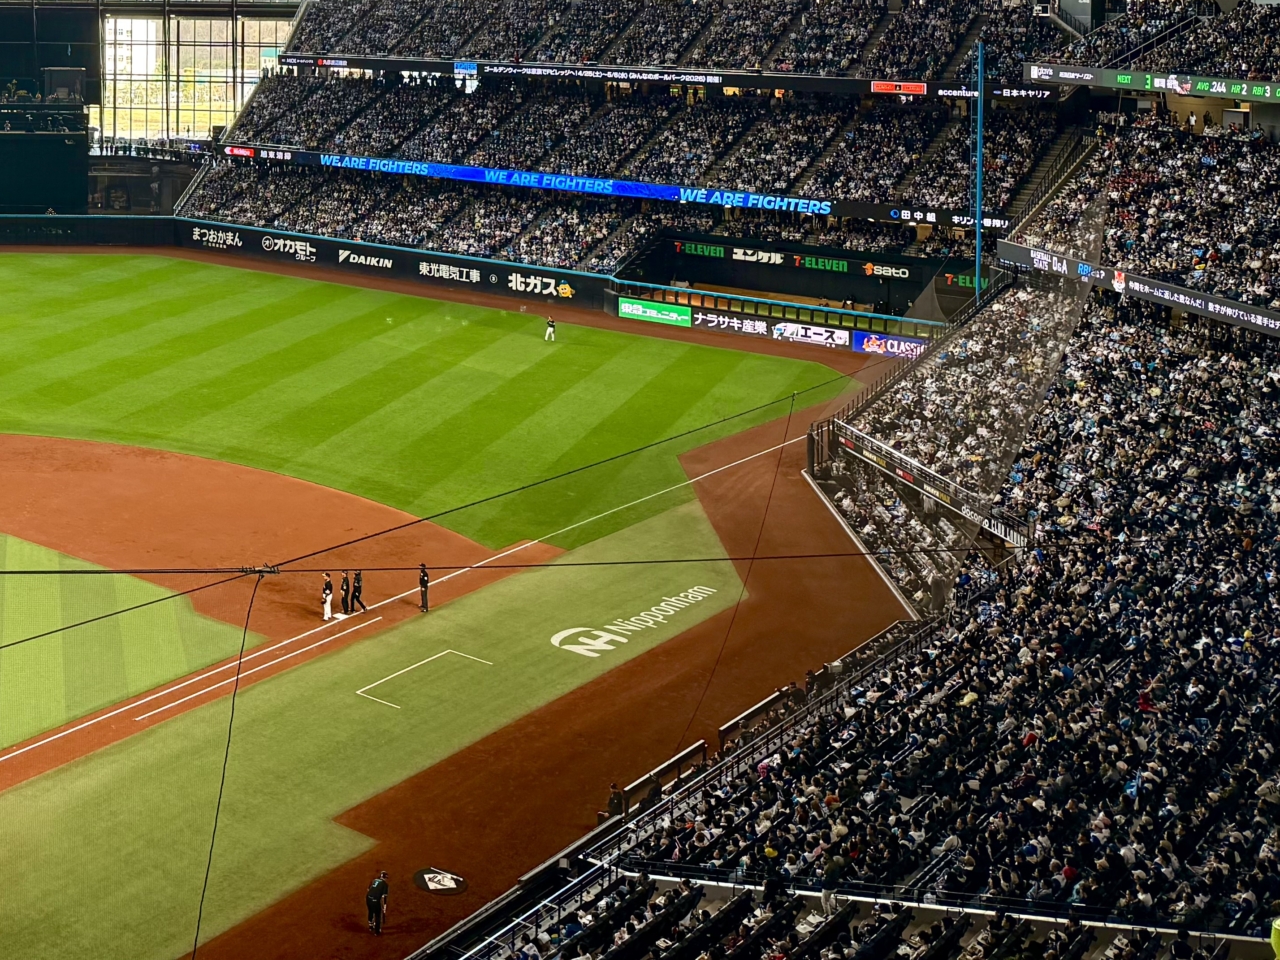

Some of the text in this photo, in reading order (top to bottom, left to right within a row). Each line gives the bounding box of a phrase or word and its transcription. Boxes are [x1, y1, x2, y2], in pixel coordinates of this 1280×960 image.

[1117, 74, 1132, 84] NEXT
[938, 89, 979, 97] accenture
[1002, 89, 1050, 98] 日本キャリア
[1196, 81, 1271, 97] AVG .244 HR 2 RBI 3
[320, 154, 428, 175] WE ARE FIGHTERS
[484, 170, 613, 193] WE ARE FIGHTERS
[680, 188, 832, 215] WE ARE FIGHTERS
[901, 209, 936, 222] 田中組
[951, 215, 1009, 228] キリン番搾り
[192, 226, 242, 247] まつおかまん
[274, 238, 316, 256] オカモト
[295, 253, 316, 262] グループ
[349, 253, 393, 269] DAIKIN
[419, 261, 480, 283] 東光電気工事
[873, 265, 909, 278] sato
[508, 272, 558, 297] 北ガス
[621, 302, 689, 321] 東急コミュニティー
[693, 311, 767, 335] ナラサキ産業
[800, 326, 836, 342] エース
[603, 585, 718, 635] Nipponham
